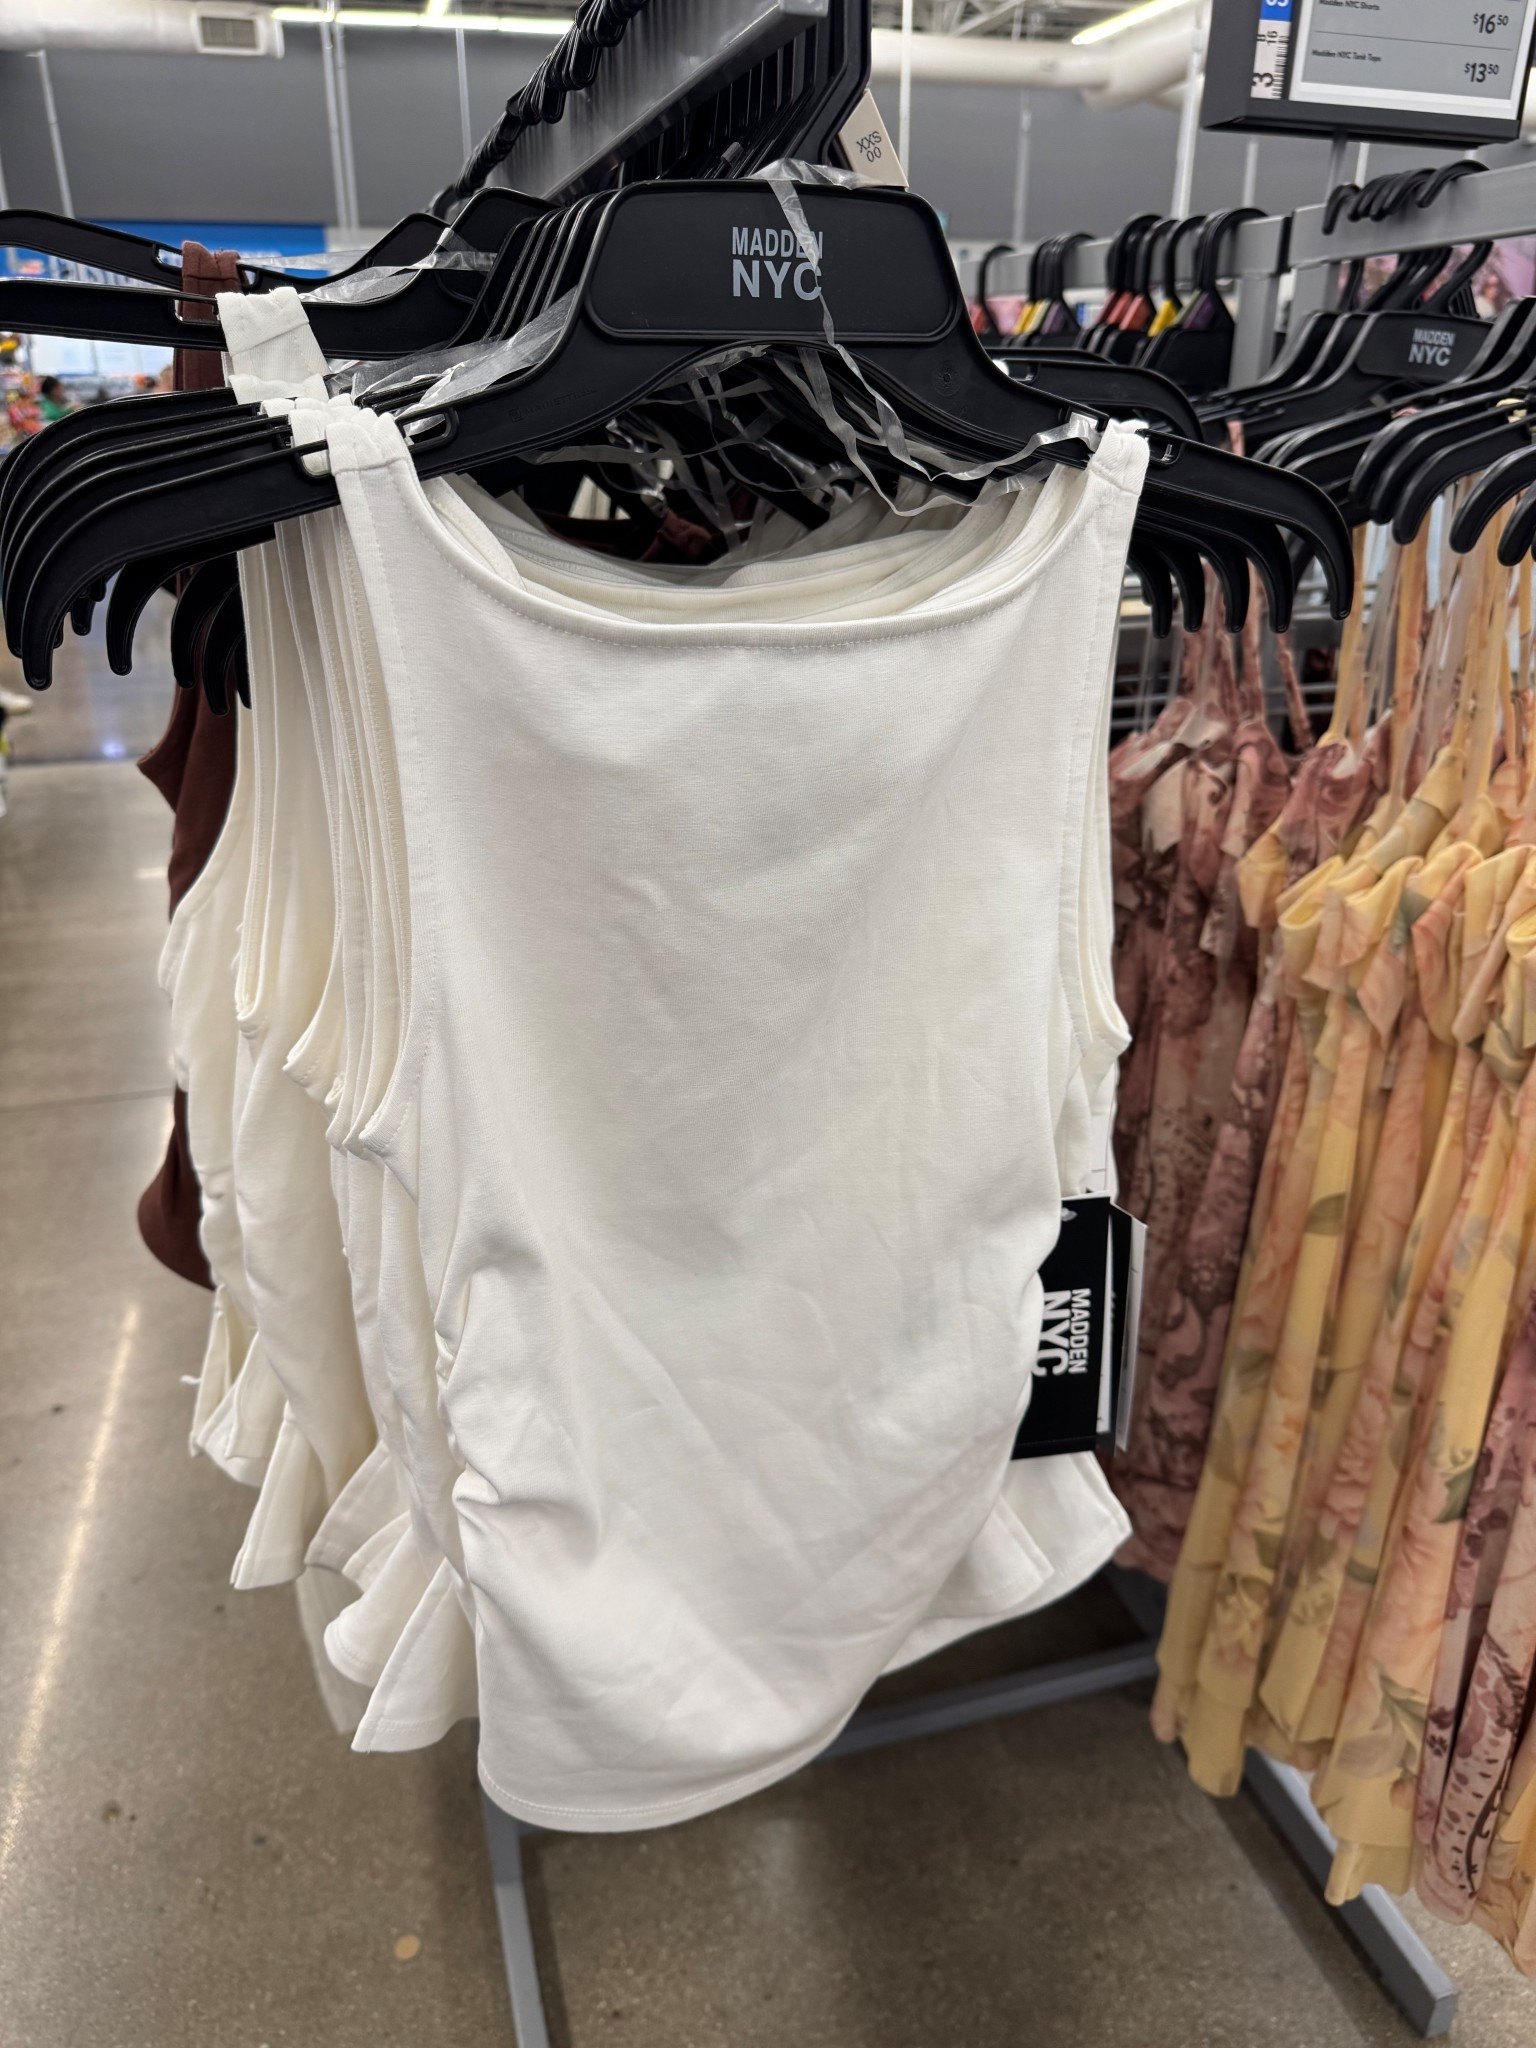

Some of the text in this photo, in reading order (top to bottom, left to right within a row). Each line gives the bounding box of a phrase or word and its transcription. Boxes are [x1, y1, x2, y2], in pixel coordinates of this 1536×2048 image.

[856, 131, 882, 153] XXS
[866, 146, 882, 162] 00
[732, 259, 822, 301] NYC
[1412, 328, 1456, 346] MADDEN
[1408, 344, 1451, 367] NYC
[1031, 1290, 1072, 1377] NYC
[1068, 1288, 1091, 1374] MADDEN
